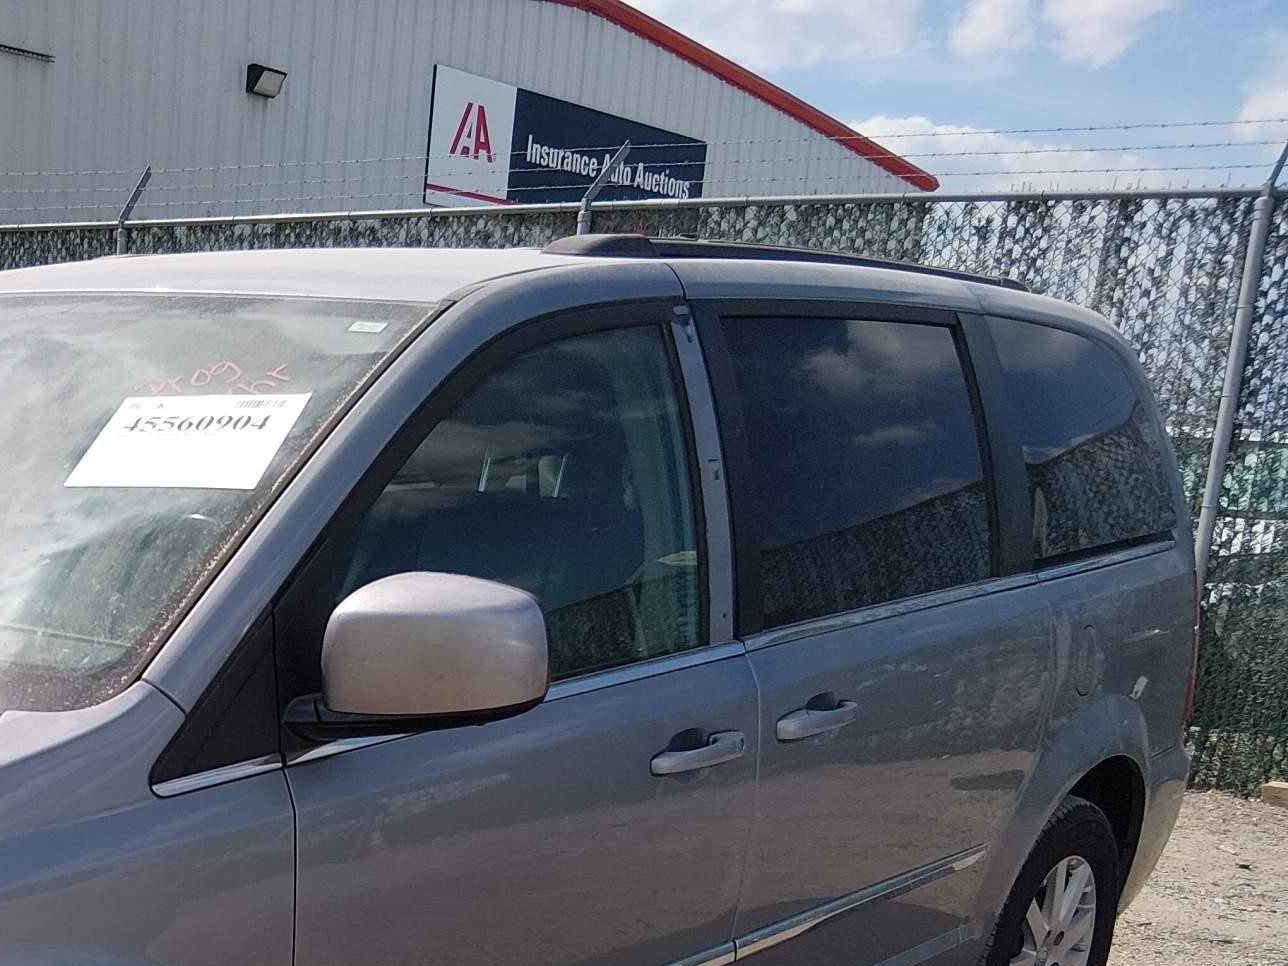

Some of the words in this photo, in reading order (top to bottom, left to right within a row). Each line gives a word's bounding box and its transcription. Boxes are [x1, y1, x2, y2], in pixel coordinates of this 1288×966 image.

[526, 133, 598, 178] Insurance
[633, 162, 690, 199] Auctions
[123, 414, 272, 432] 45560904
